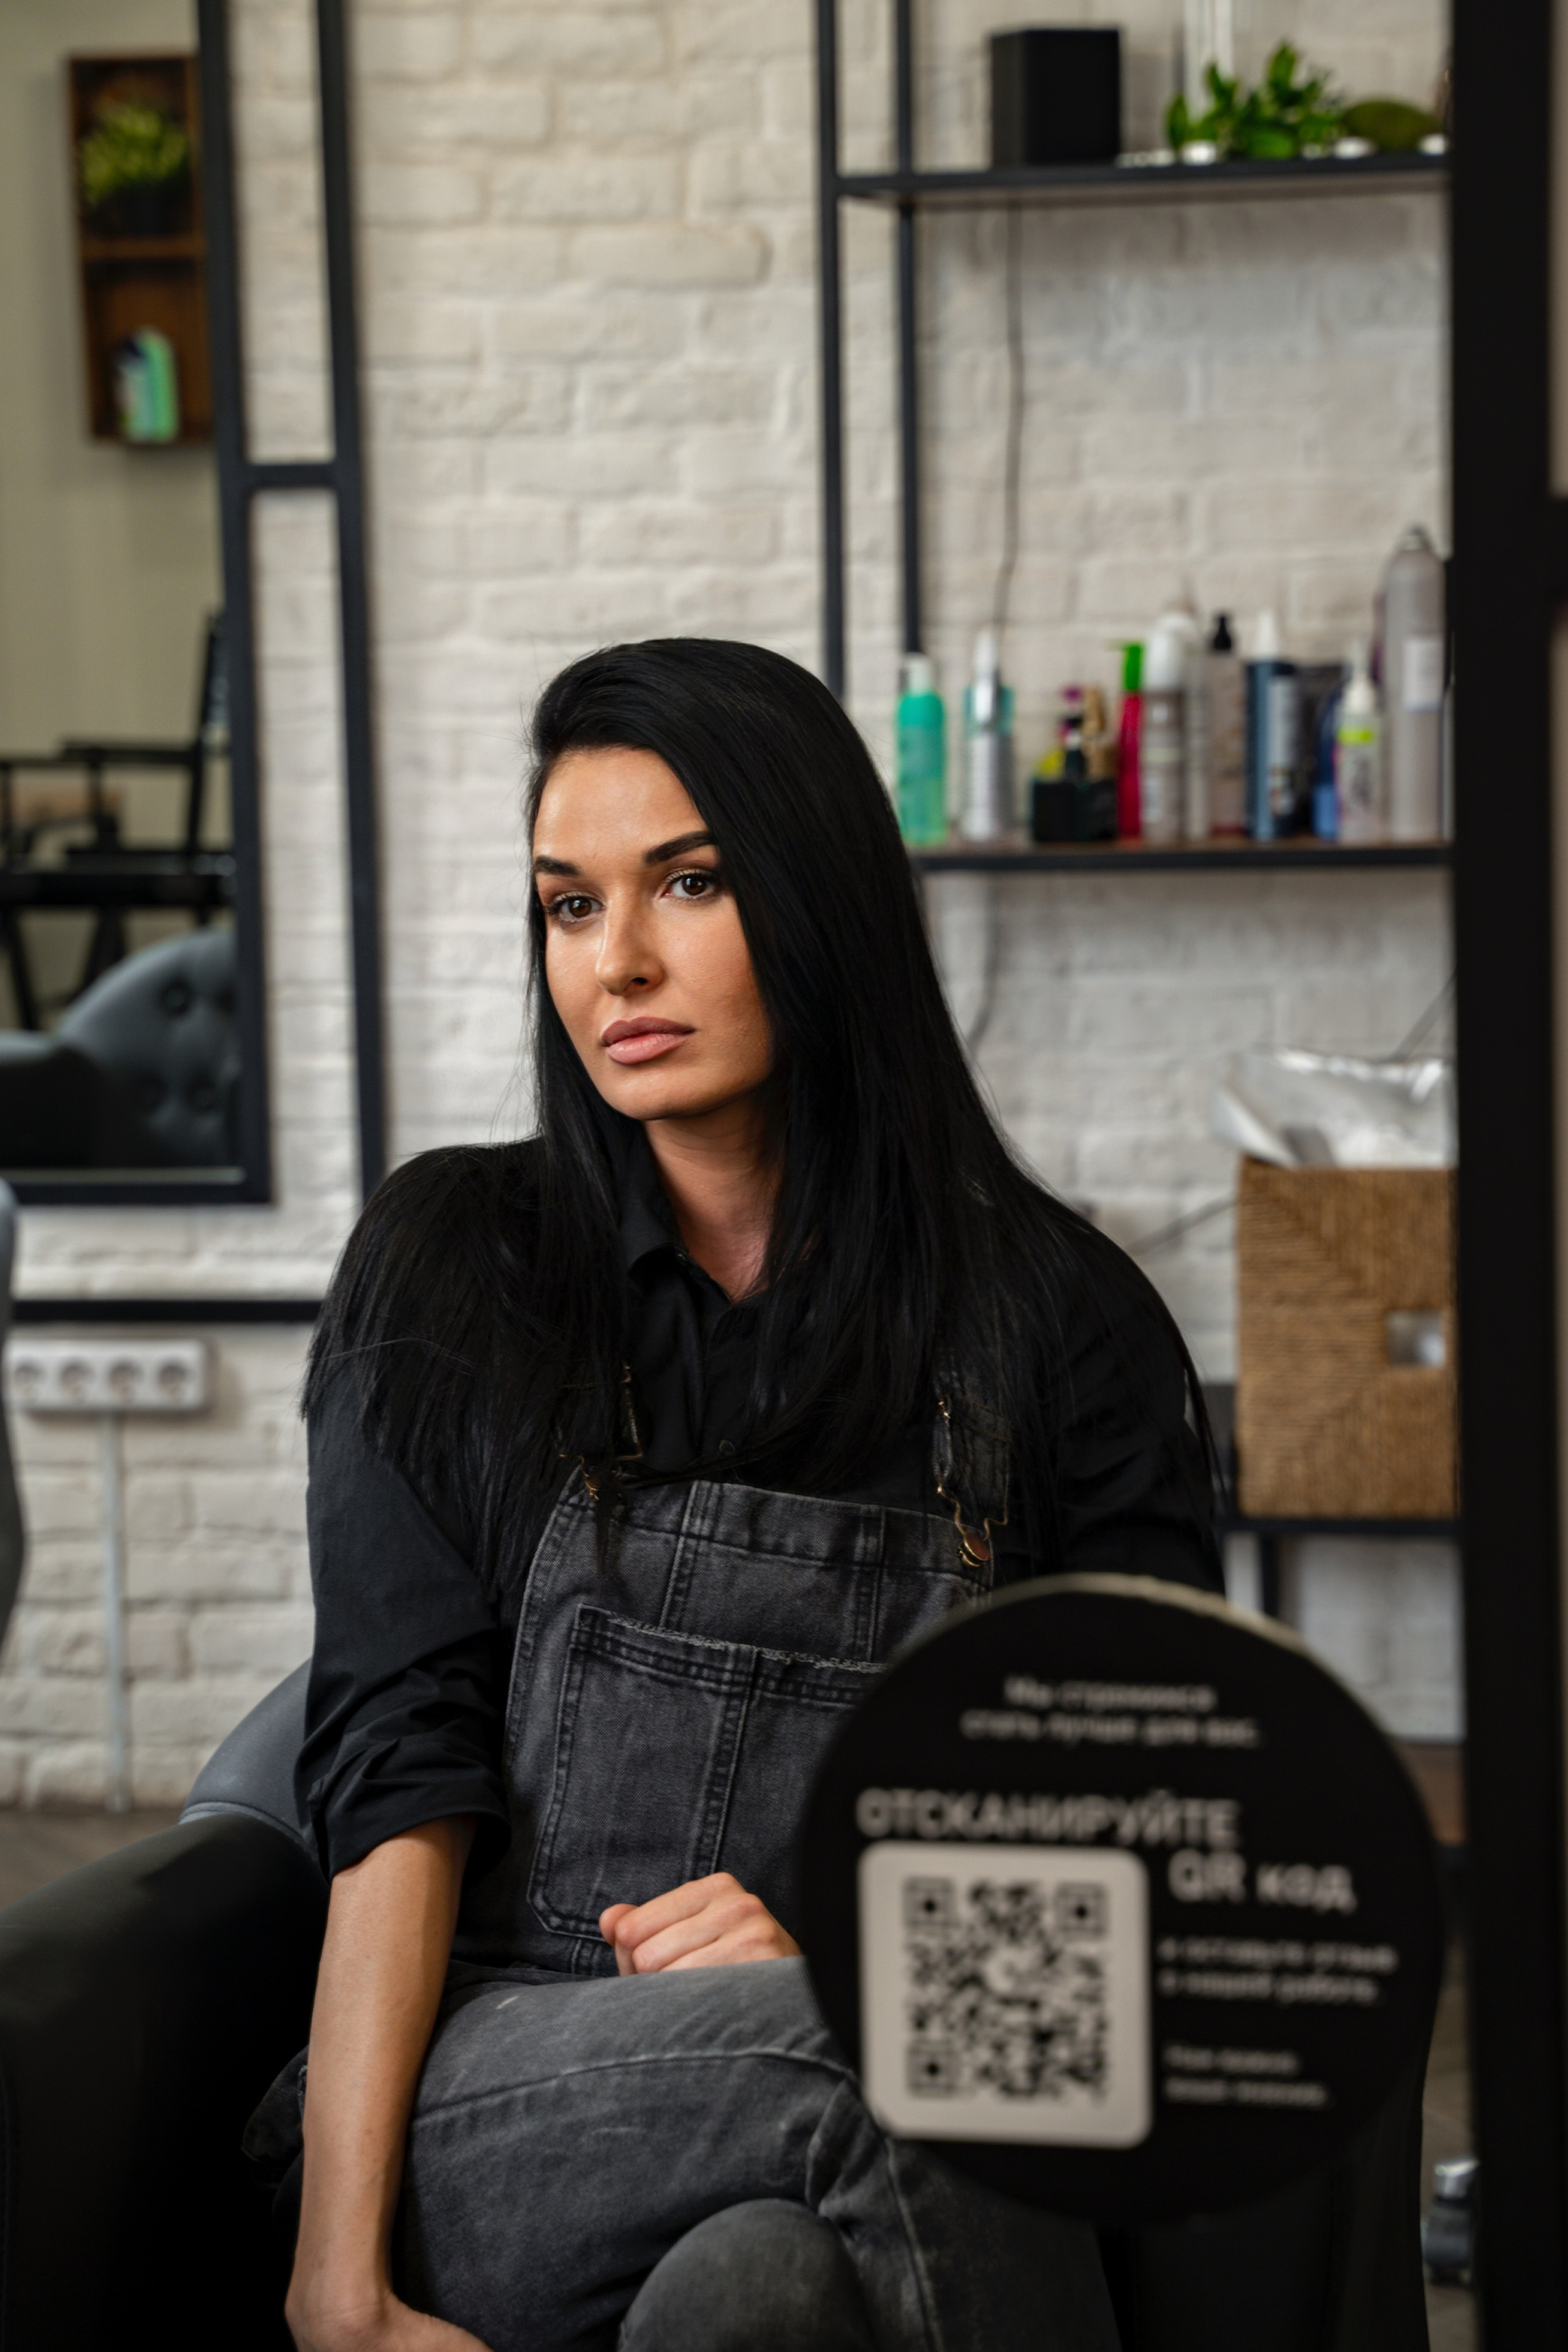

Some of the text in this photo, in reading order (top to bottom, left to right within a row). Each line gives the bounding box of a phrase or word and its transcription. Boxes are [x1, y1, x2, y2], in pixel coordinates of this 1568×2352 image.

[856, 1788, 1238, 1845] ОТСКАНИРУЙТЕ
[1168, 1849, 1357, 1912] QR код
